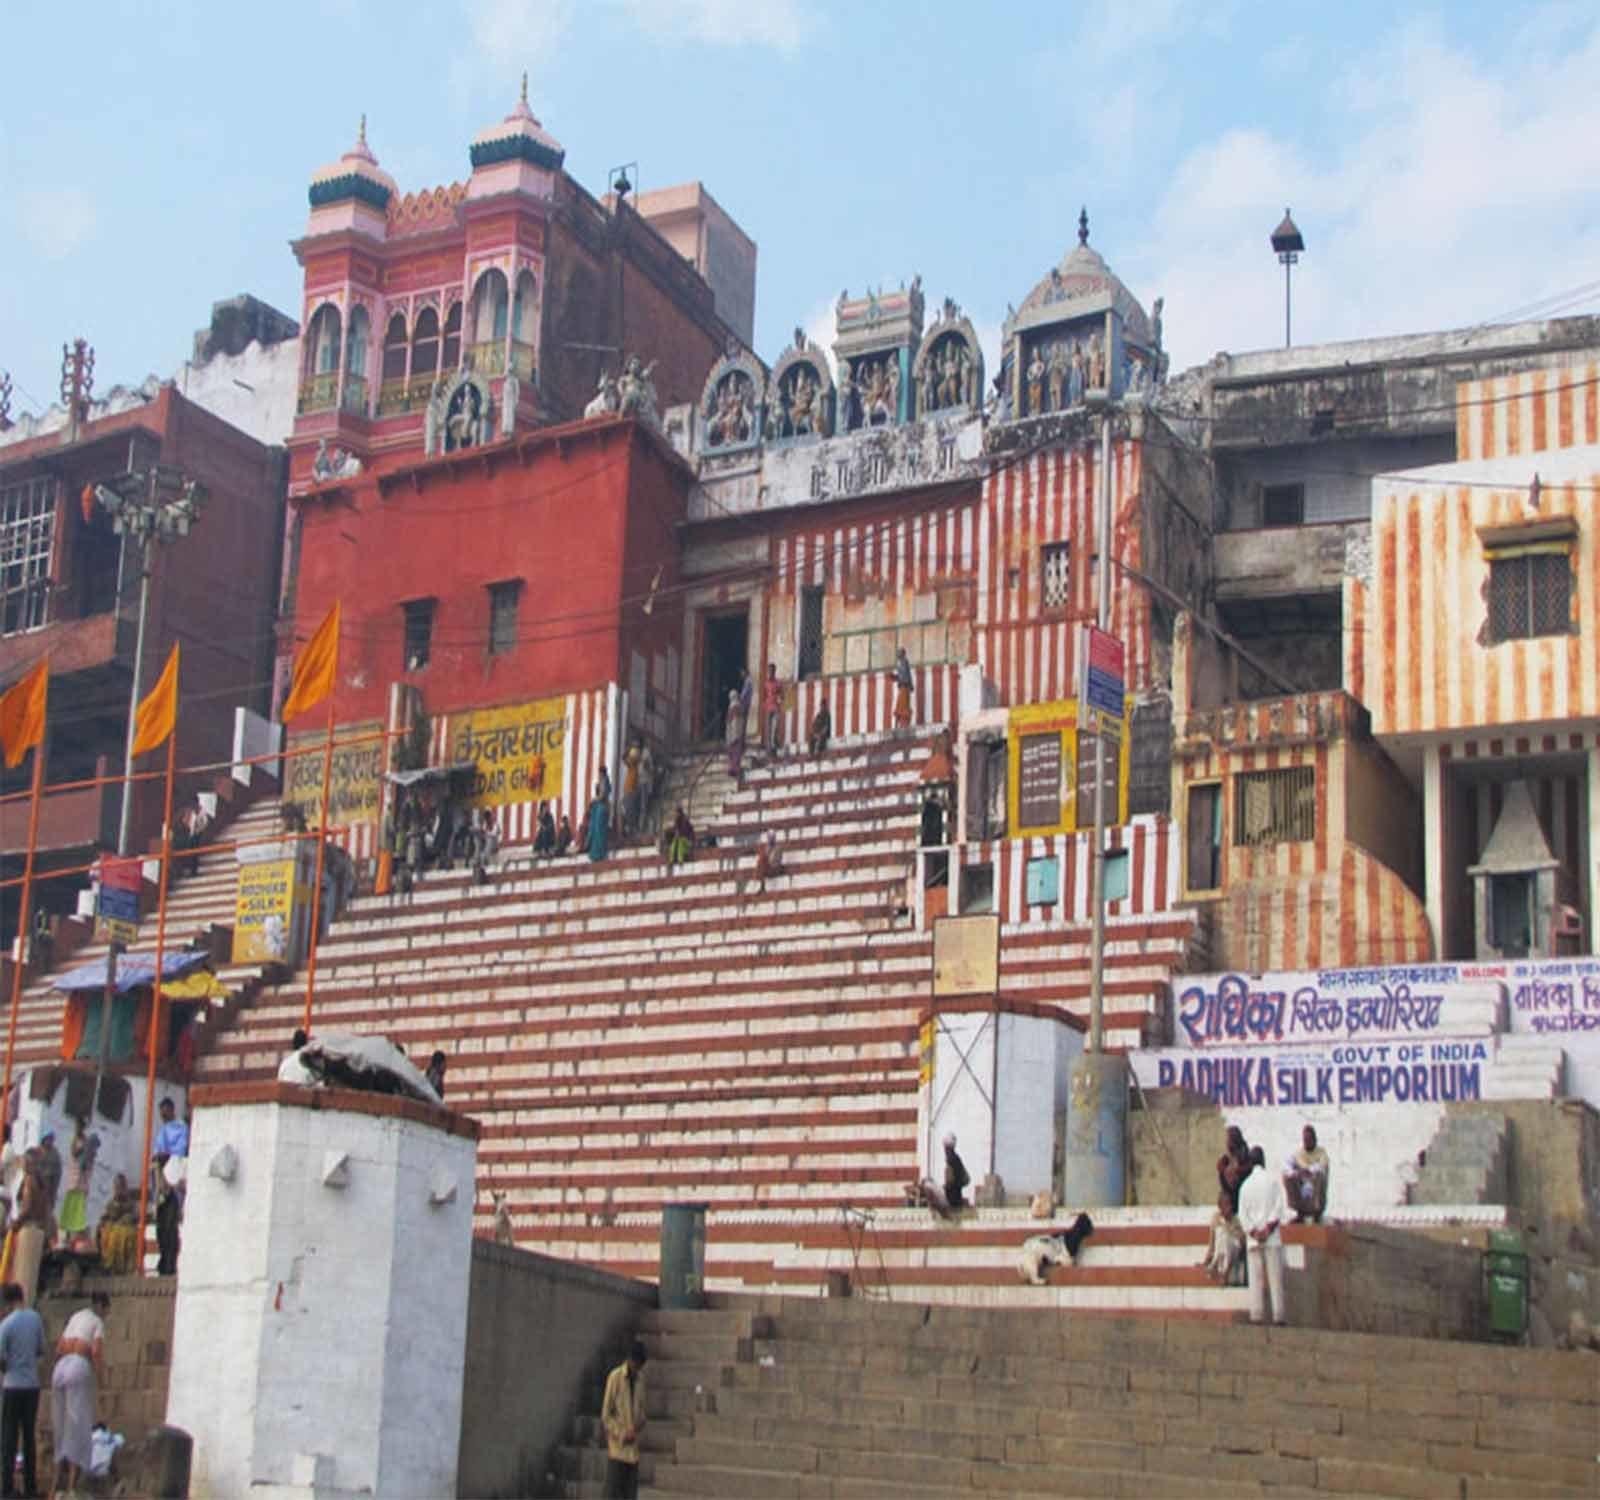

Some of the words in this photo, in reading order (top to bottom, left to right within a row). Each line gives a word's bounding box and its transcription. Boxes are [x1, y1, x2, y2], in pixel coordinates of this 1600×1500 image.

[1179, 975, 1286, 1046] राधिका
[1332, 1045, 1390, 1063] GOVT
[1397, 1044, 1424, 1061] OF
[1431, 1041, 1487, 1060] INDIA
[1277, 1067, 1334, 1105] SILK
[1338, 1062, 1480, 1103] EMPORIUM
